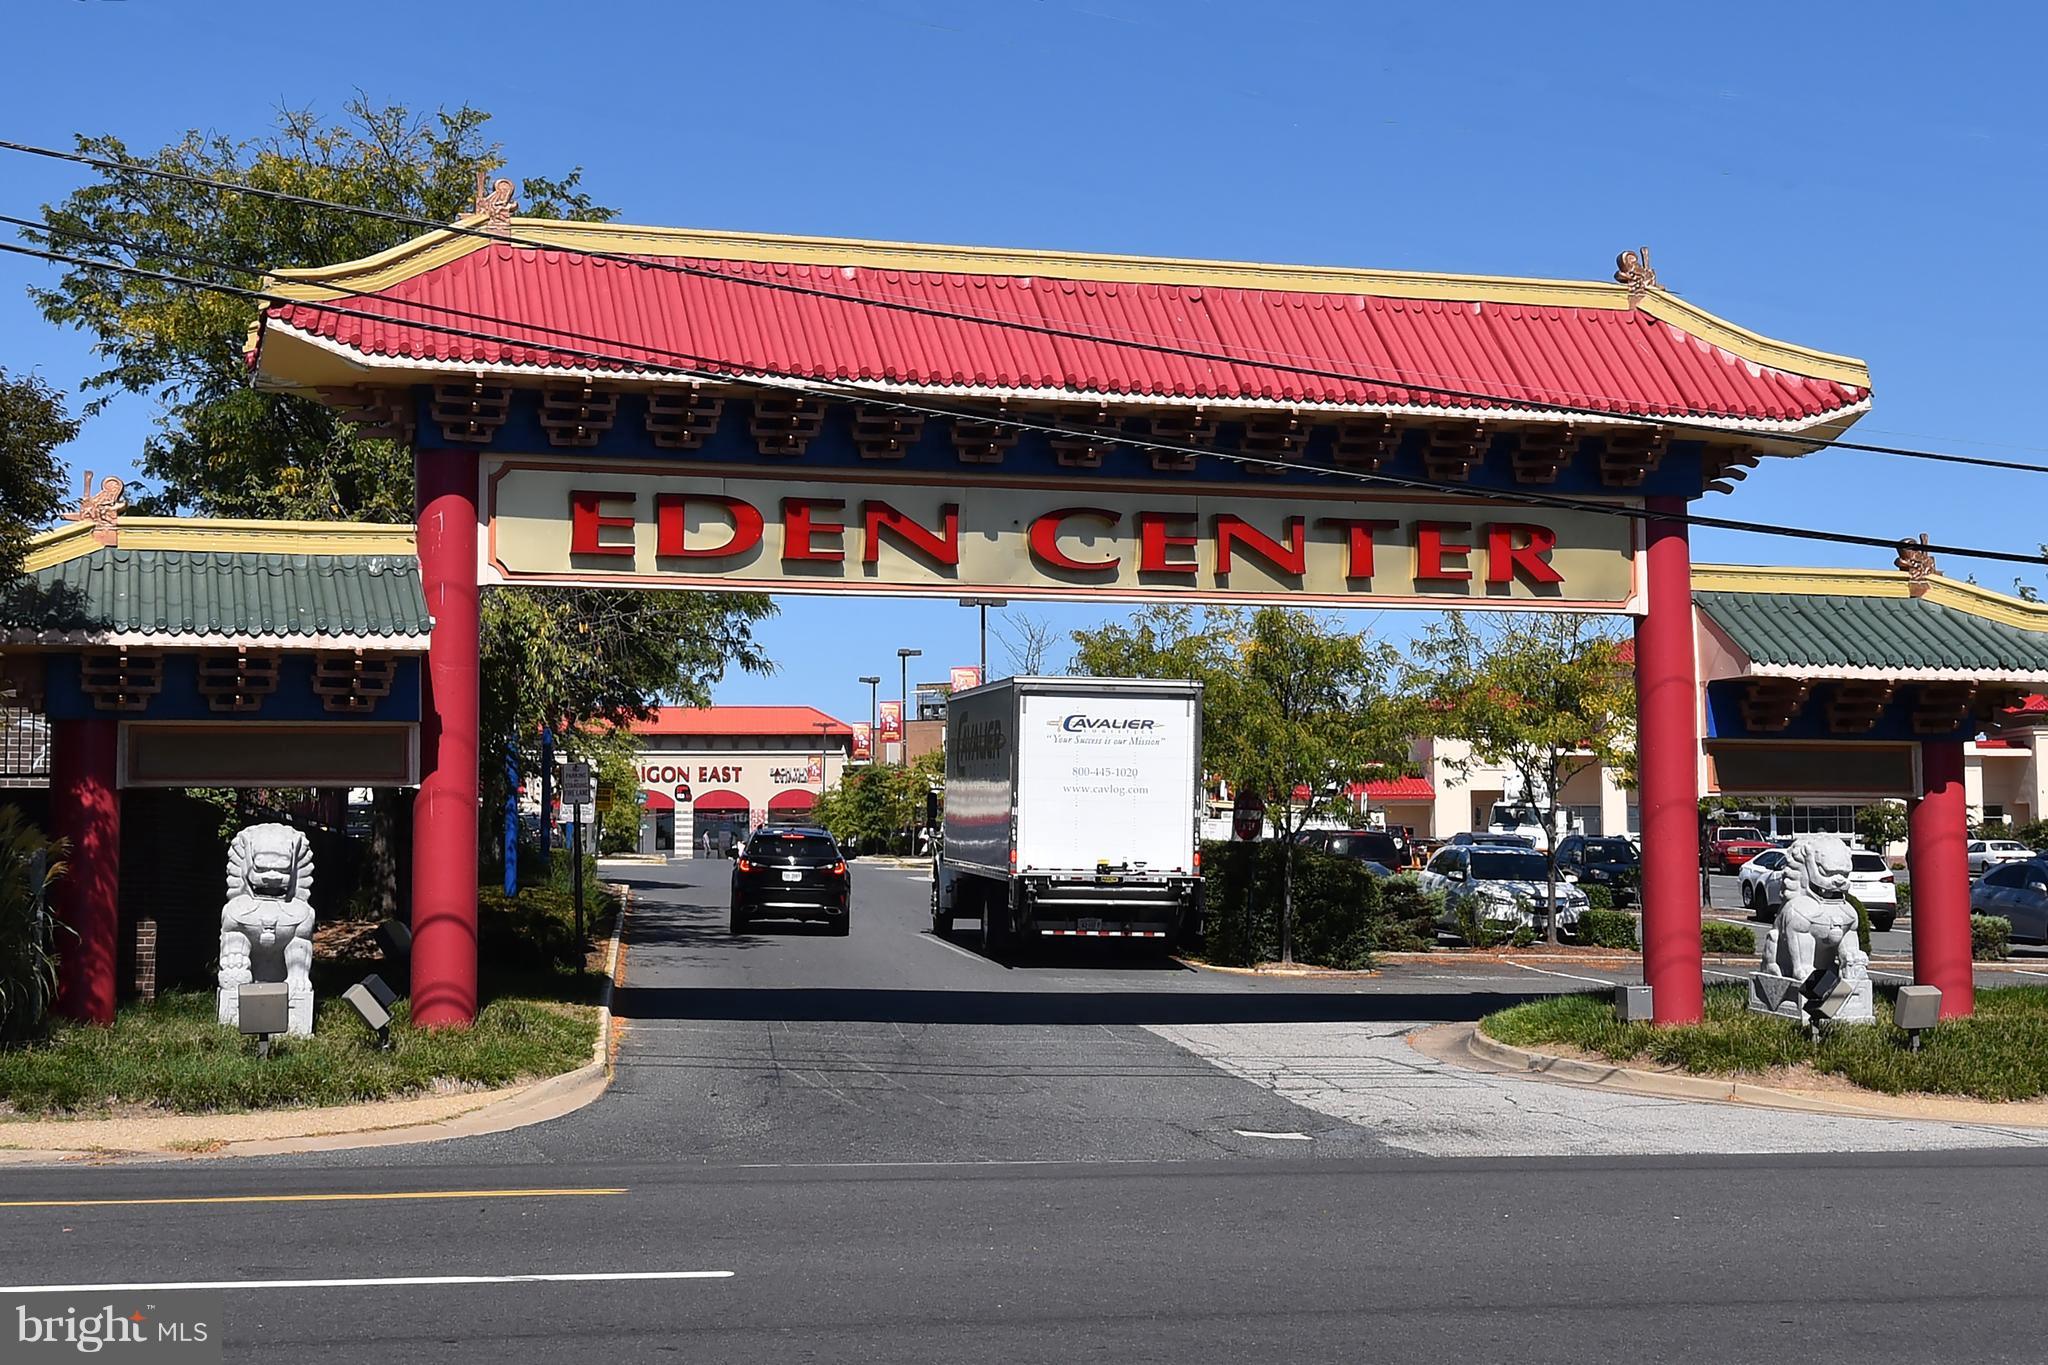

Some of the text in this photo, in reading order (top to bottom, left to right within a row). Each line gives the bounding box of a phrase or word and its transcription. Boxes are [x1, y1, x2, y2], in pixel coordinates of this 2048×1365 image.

[571, 490, 1566, 584] EDEN CENTER
[1063, 714, 1155, 732] CAVALIER
[1074, 735, 1102, 745] Success
[635, 766, 742, 783] IGON EAST
[1063, 784, 1149, 796] www.cavlog.com
